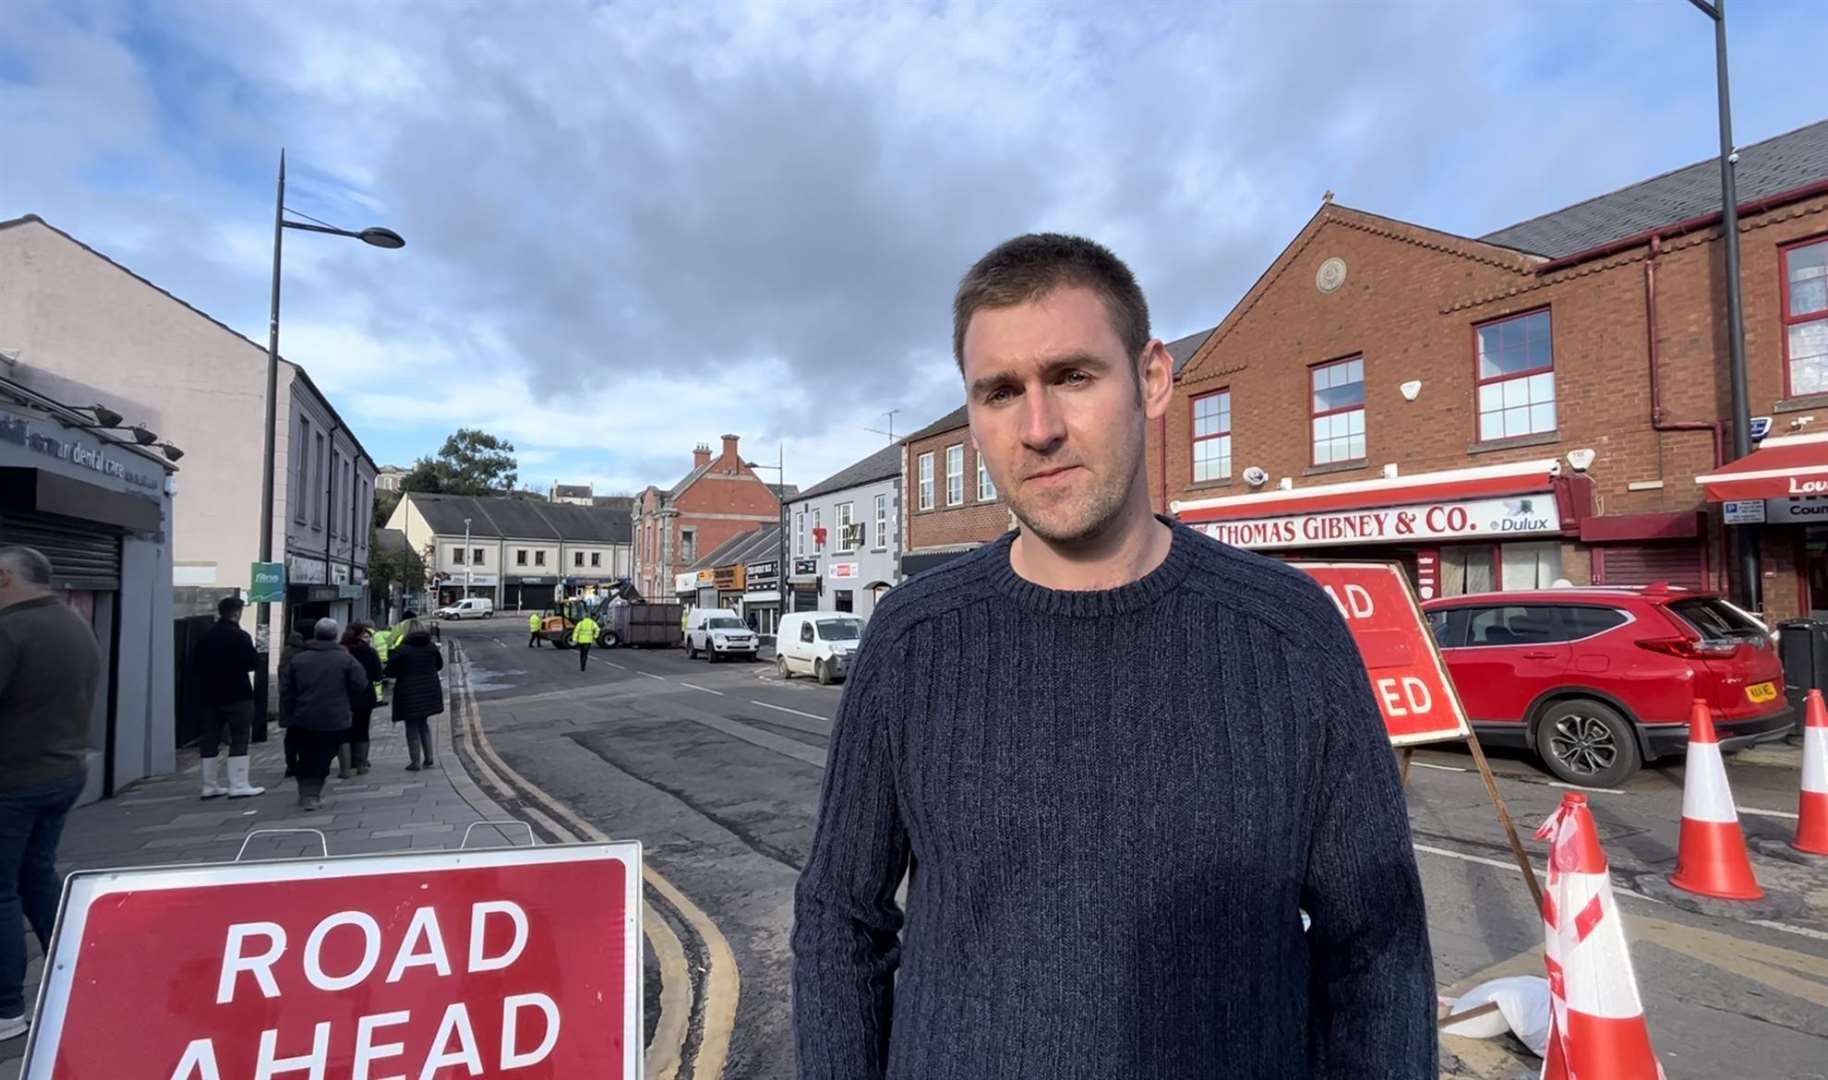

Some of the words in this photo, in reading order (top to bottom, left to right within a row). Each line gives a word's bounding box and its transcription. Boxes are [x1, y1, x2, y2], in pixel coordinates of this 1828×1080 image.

[73, 441, 104, 473] dental
[105, 457, 125, 478] care
[1216, 522, 1297, 546] THOMAS
[1303, 511, 1389, 541] GIBNEY
[1396, 510, 1417, 535] &
[1425, 506, 1477, 533] CO.
[1501, 517, 1548, 532] Dulux
[217, 900, 529, 1004] ROAD
[170, 992, 561, 1080] AHEAD
